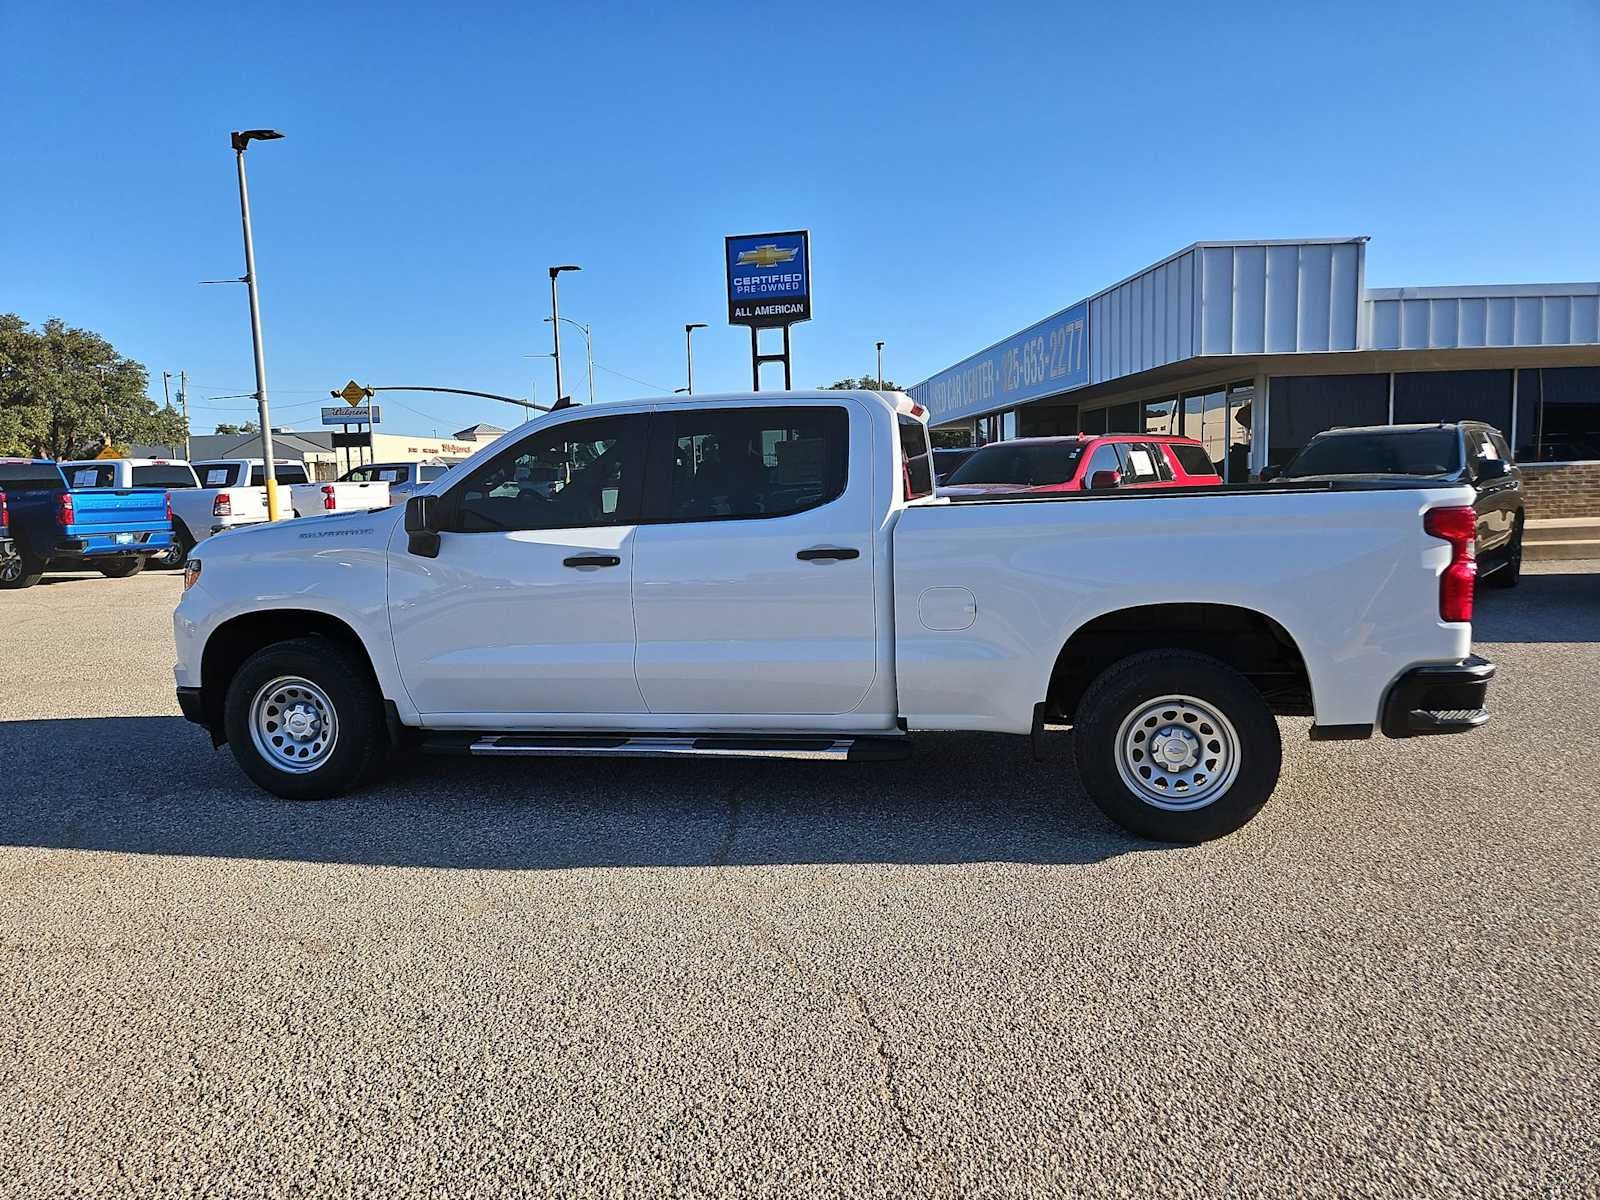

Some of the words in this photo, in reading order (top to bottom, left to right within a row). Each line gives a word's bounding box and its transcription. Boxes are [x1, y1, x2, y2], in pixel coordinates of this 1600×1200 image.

[733, 273, 802, 286] CERTIFIED
[736, 282, 799, 294] PRE-OWNED
[735, 307, 752, 317] ALL
[755, 303, 804, 316] AMERICAN
